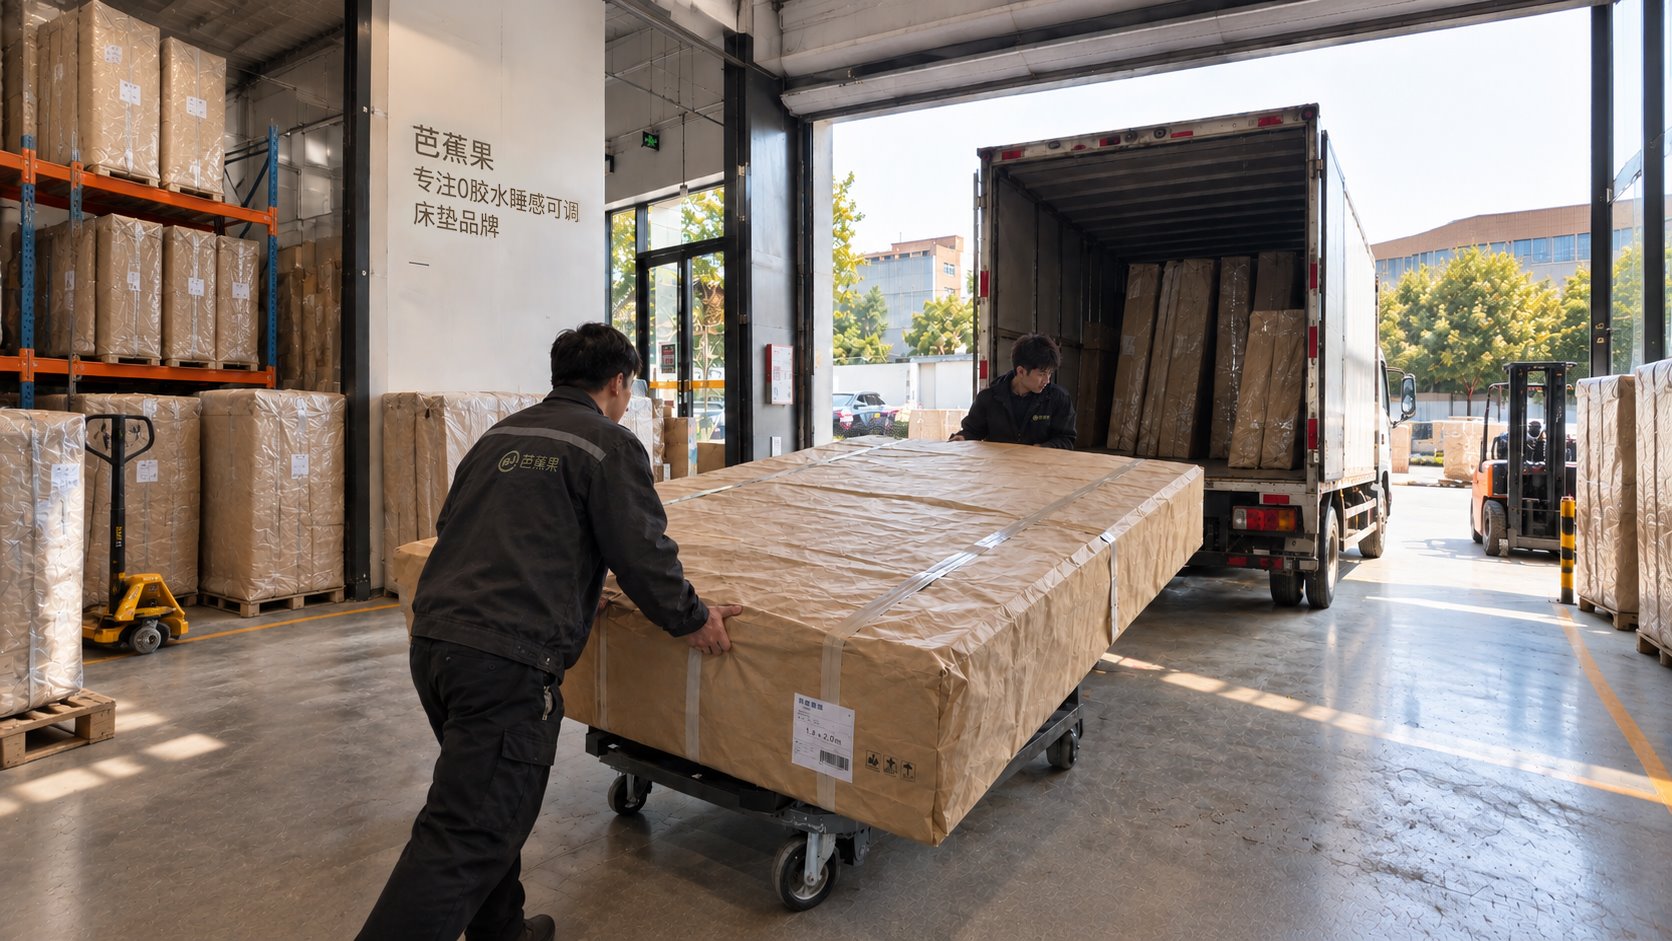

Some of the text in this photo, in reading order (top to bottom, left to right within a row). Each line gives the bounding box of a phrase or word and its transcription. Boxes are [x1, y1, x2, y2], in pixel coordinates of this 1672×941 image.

[412, 124, 494, 171] 芭蕉果
[412, 165, 580, 223] 专注0胶水睡感可调
[413, 200, 500, 239] 床垫品牌
[520, 453, 560, 472] 芭蕉果
